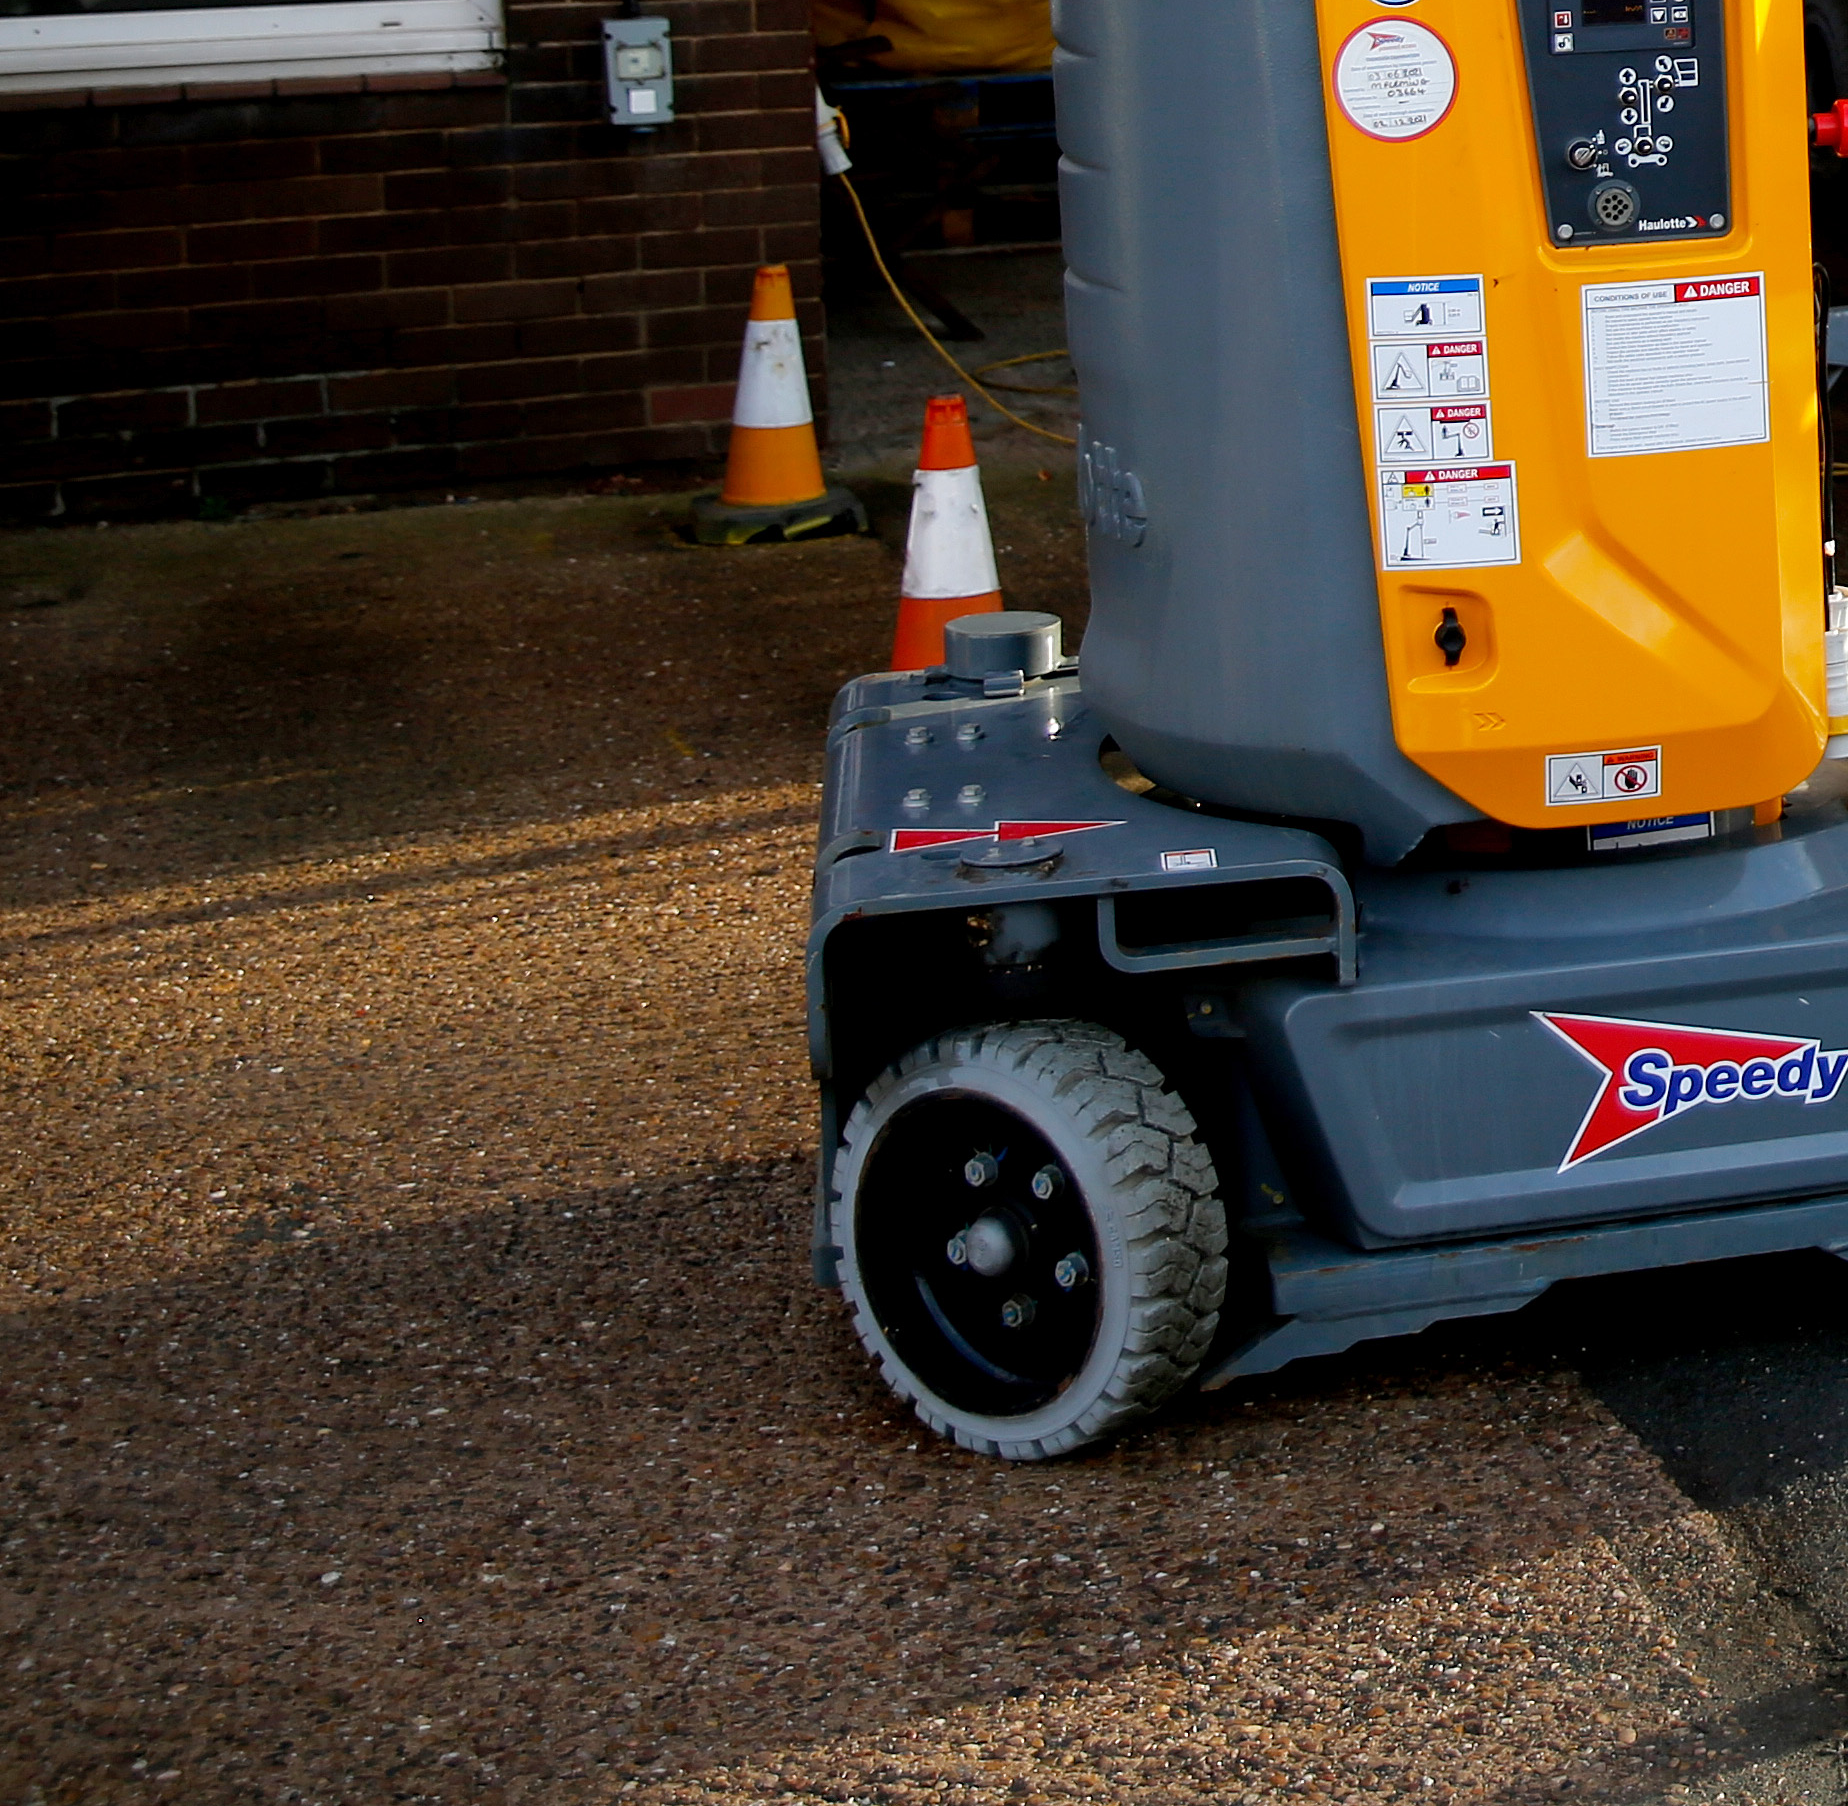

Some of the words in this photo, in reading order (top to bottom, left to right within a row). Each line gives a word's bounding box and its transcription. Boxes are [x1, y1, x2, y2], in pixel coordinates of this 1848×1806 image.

[1638, 218, 1687, 232] Haulotte
[1407, 282, 1440, 293] NOTICE
[1699, 281, 1750, 297] DANGER
[1594, 293, 1640, 303] CONDITIONS
[1641, 293, 1652, 301] OF
[1653, 290, 1668, 299] USE
[1443, 344, 1478, 355] DANGER
[1447, 407, 1481, 418] DANGER
[1438, 469, 1479, 480] DANGER
[1616, 751, 1655, 763] WARNING
[1626, 816, 1674, 830] NOTICE
